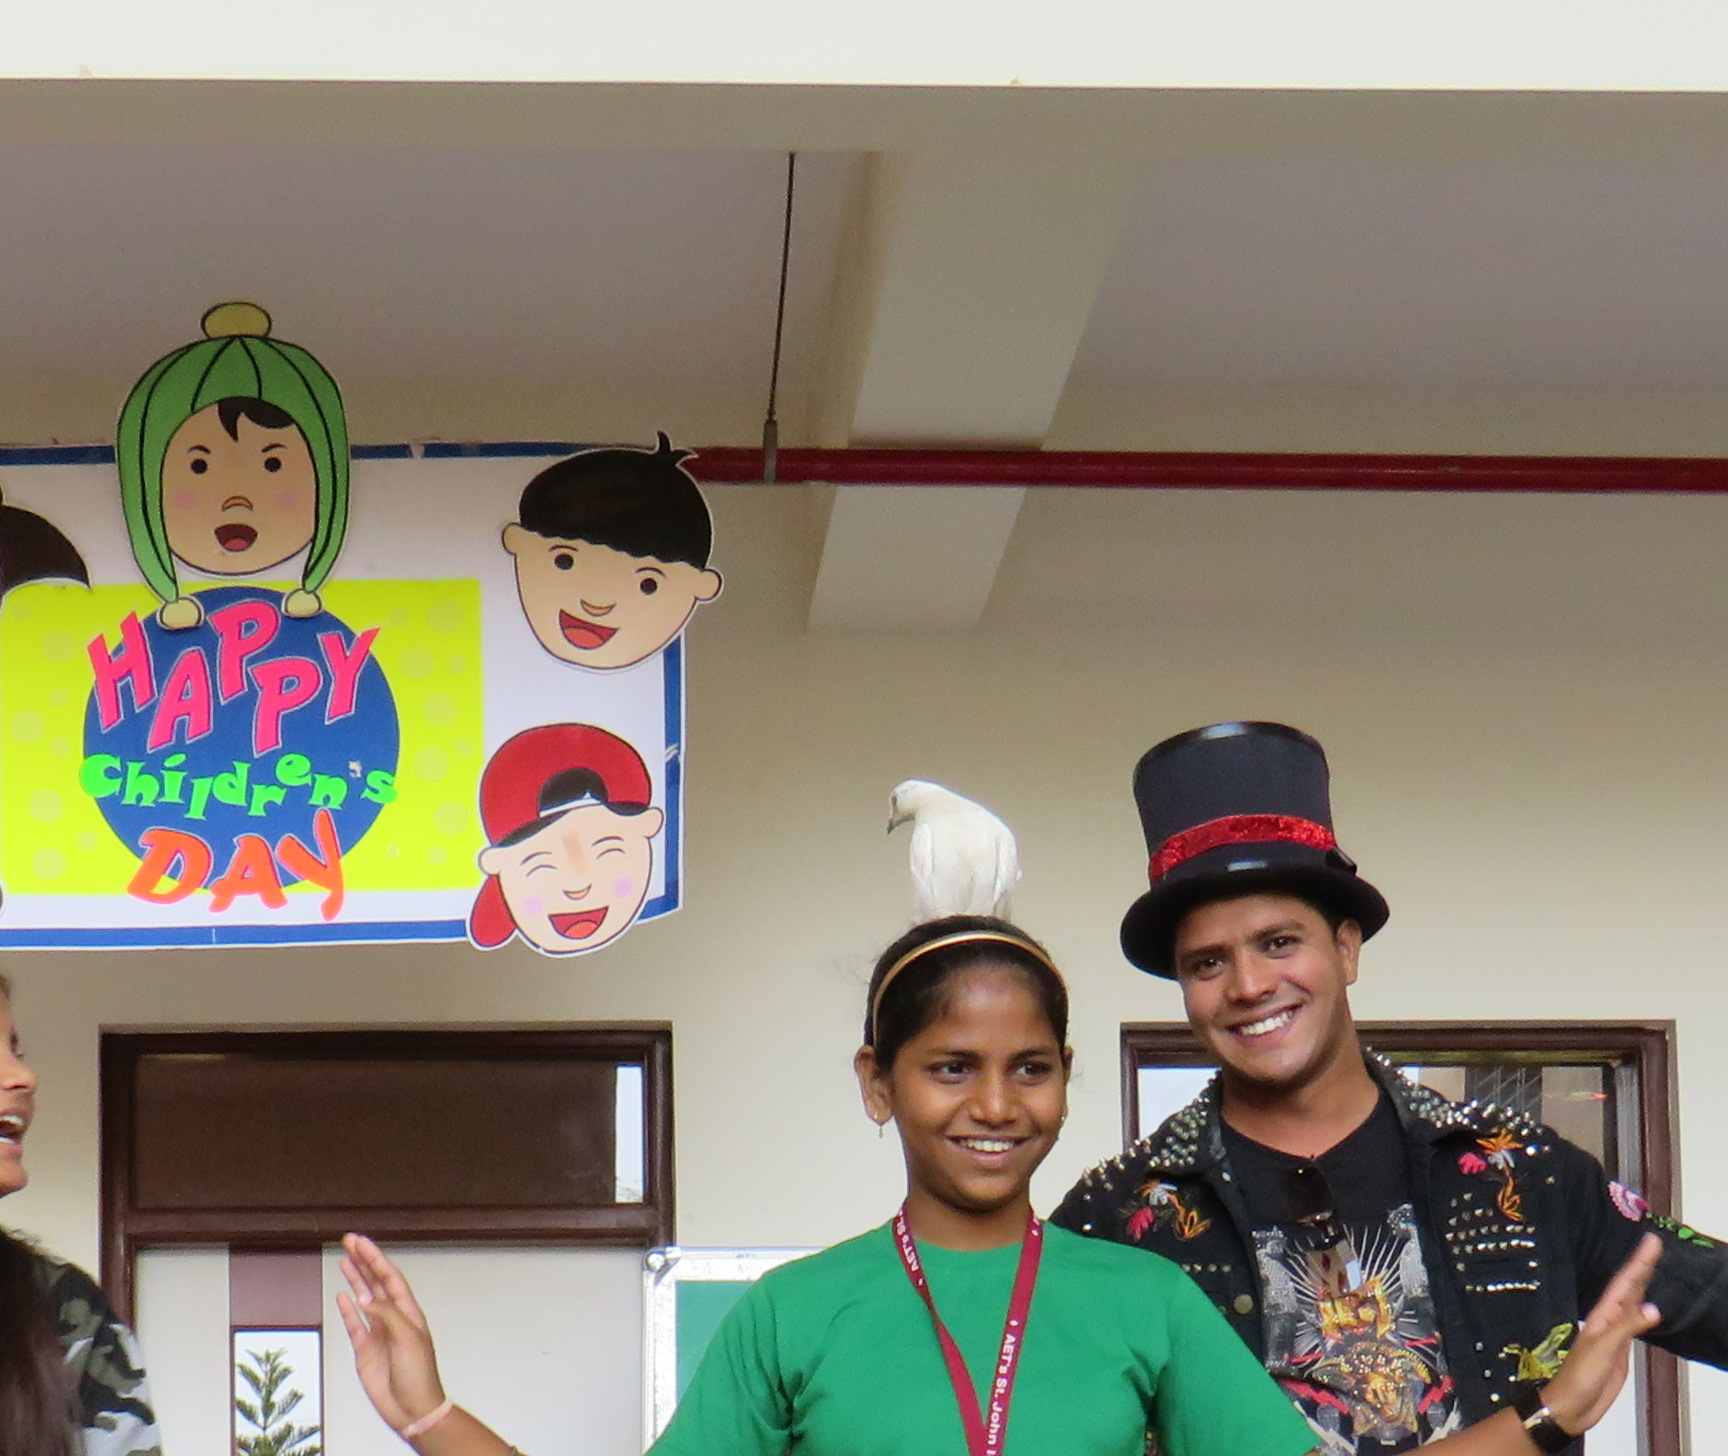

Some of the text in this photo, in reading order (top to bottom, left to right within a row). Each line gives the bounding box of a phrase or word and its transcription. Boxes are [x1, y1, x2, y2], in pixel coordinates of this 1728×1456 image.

[87, 599, 381, 758] HAPPY
[79, 753, 398, 819] Children's
[127, 808, 345, 922] DAY
[987, 1400, 1003, 1446] John
